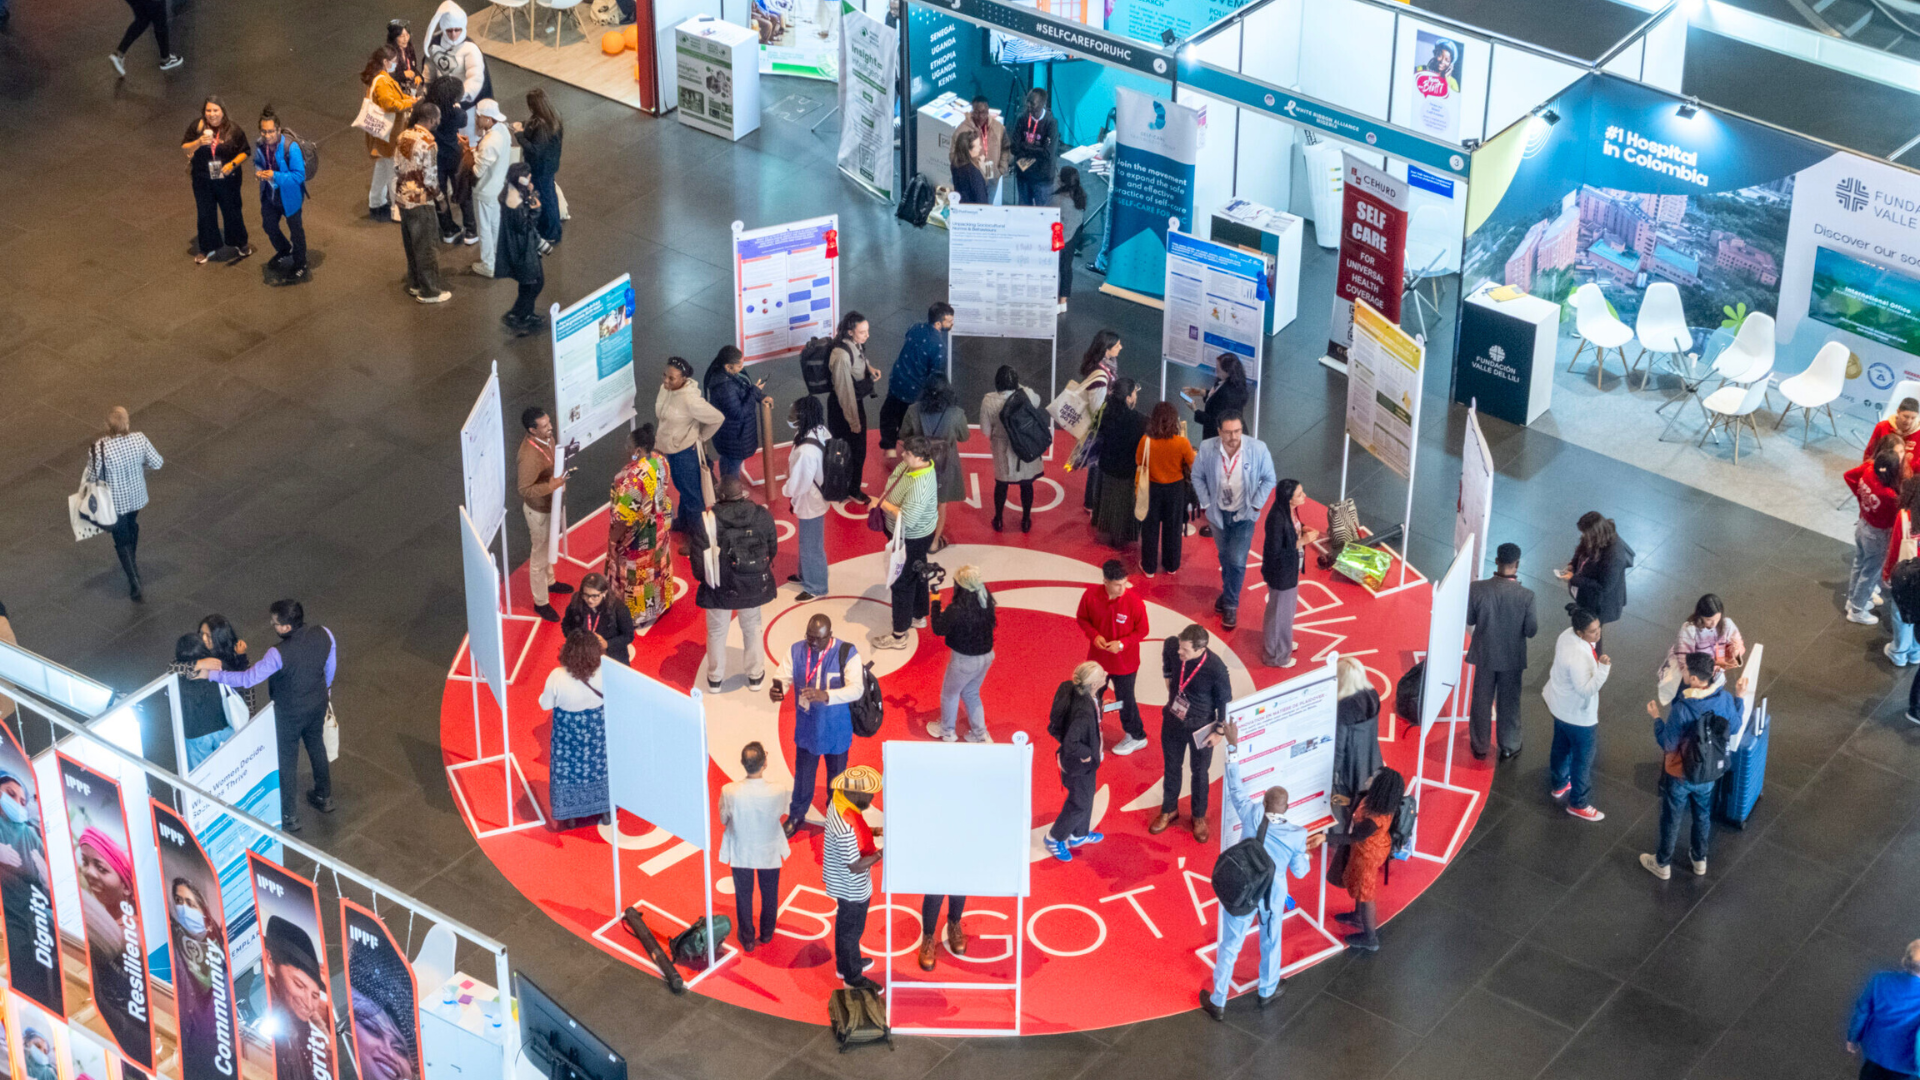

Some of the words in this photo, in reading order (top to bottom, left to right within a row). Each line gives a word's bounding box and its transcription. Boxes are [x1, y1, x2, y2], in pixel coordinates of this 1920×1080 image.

[930, 23, 956, 42] SENEGAL
[1036, 23, 1131, 61] #SELFCAREFORUHC
[931, 37, 956, 55] UGANDA
[930, 51, 956, 70] ETHIOPIA
[931, 61, 956, 80] UGANDA
[938, 72, 956, 87] KENYA
[1295, 106, 1312, 116] WHITE
[1313, 111, 1333, 123] RIBBON
[1334, 118, 1359, 132] ALLIANCE
[1316, 117, 1338, 129] NIGERIA
[1605, 125, 1624, 143] #1
[1626, 131, 1698, 167] Hospital
[1117, 158, 1132, 169] Join
[1134, 161, 1146, 172] the
[1148, 168, 1187, 186] movement
[1603, 140, 1620, 158] in
[1623, 147, 1709, 187] Colombia
[1117, 168, 1124, 176] to
[1126, 172, 1155, 185] expand
[1156, 178, 1169, 188] the
[1170, 183, 1185, 195] safe
[1127, 180, 1142, 189] and
[1144, 184, 1174, 200] effective
[1363, 175, 1396, 198] CEHURD
[1145, 194, 1153, 202] of
[1155, 197, 1187, 214] self-care
[1356, 201, 1387, 230] SELF
[1874, 206, 1917, 230] VALLE
[1352, 222, 1387, 254] CARE
[1813, 223, 1870, 250] Discover
[1874, 245, 1897, 258] our
[1360, 252, 1375, 266] FOR
[1346, 259, 1385, 285] UNIVERSAL
[1352, 274, 1379, 293] HEALTH
[1345, 283, 1384, 309] COVERAGE
[1844, 286, 1889, 306] International
[1890, 302, 1911, 314] Office
[1471, 361, 1492, 374] VALLE
[1493, 369, 1507, 379] DEL
[1507, 373, 1520, 383] LILI
[1476, 356, 1516, 374] FUNDACIÓN
[64, 773, 91, 796] IPPF
[213, 766, 240, 791] Women
[226, 769, 248, 790] Thrive
[159, 822, 185, 847] IPPF
[256, 873, 284, 897] IPPF
[30, 884, 54, 969] Dignity
[350, 925, 379, 949] IPPF
[120, 901, 146, 1022] Resilience
[204, 936, 232, 1076] Community
